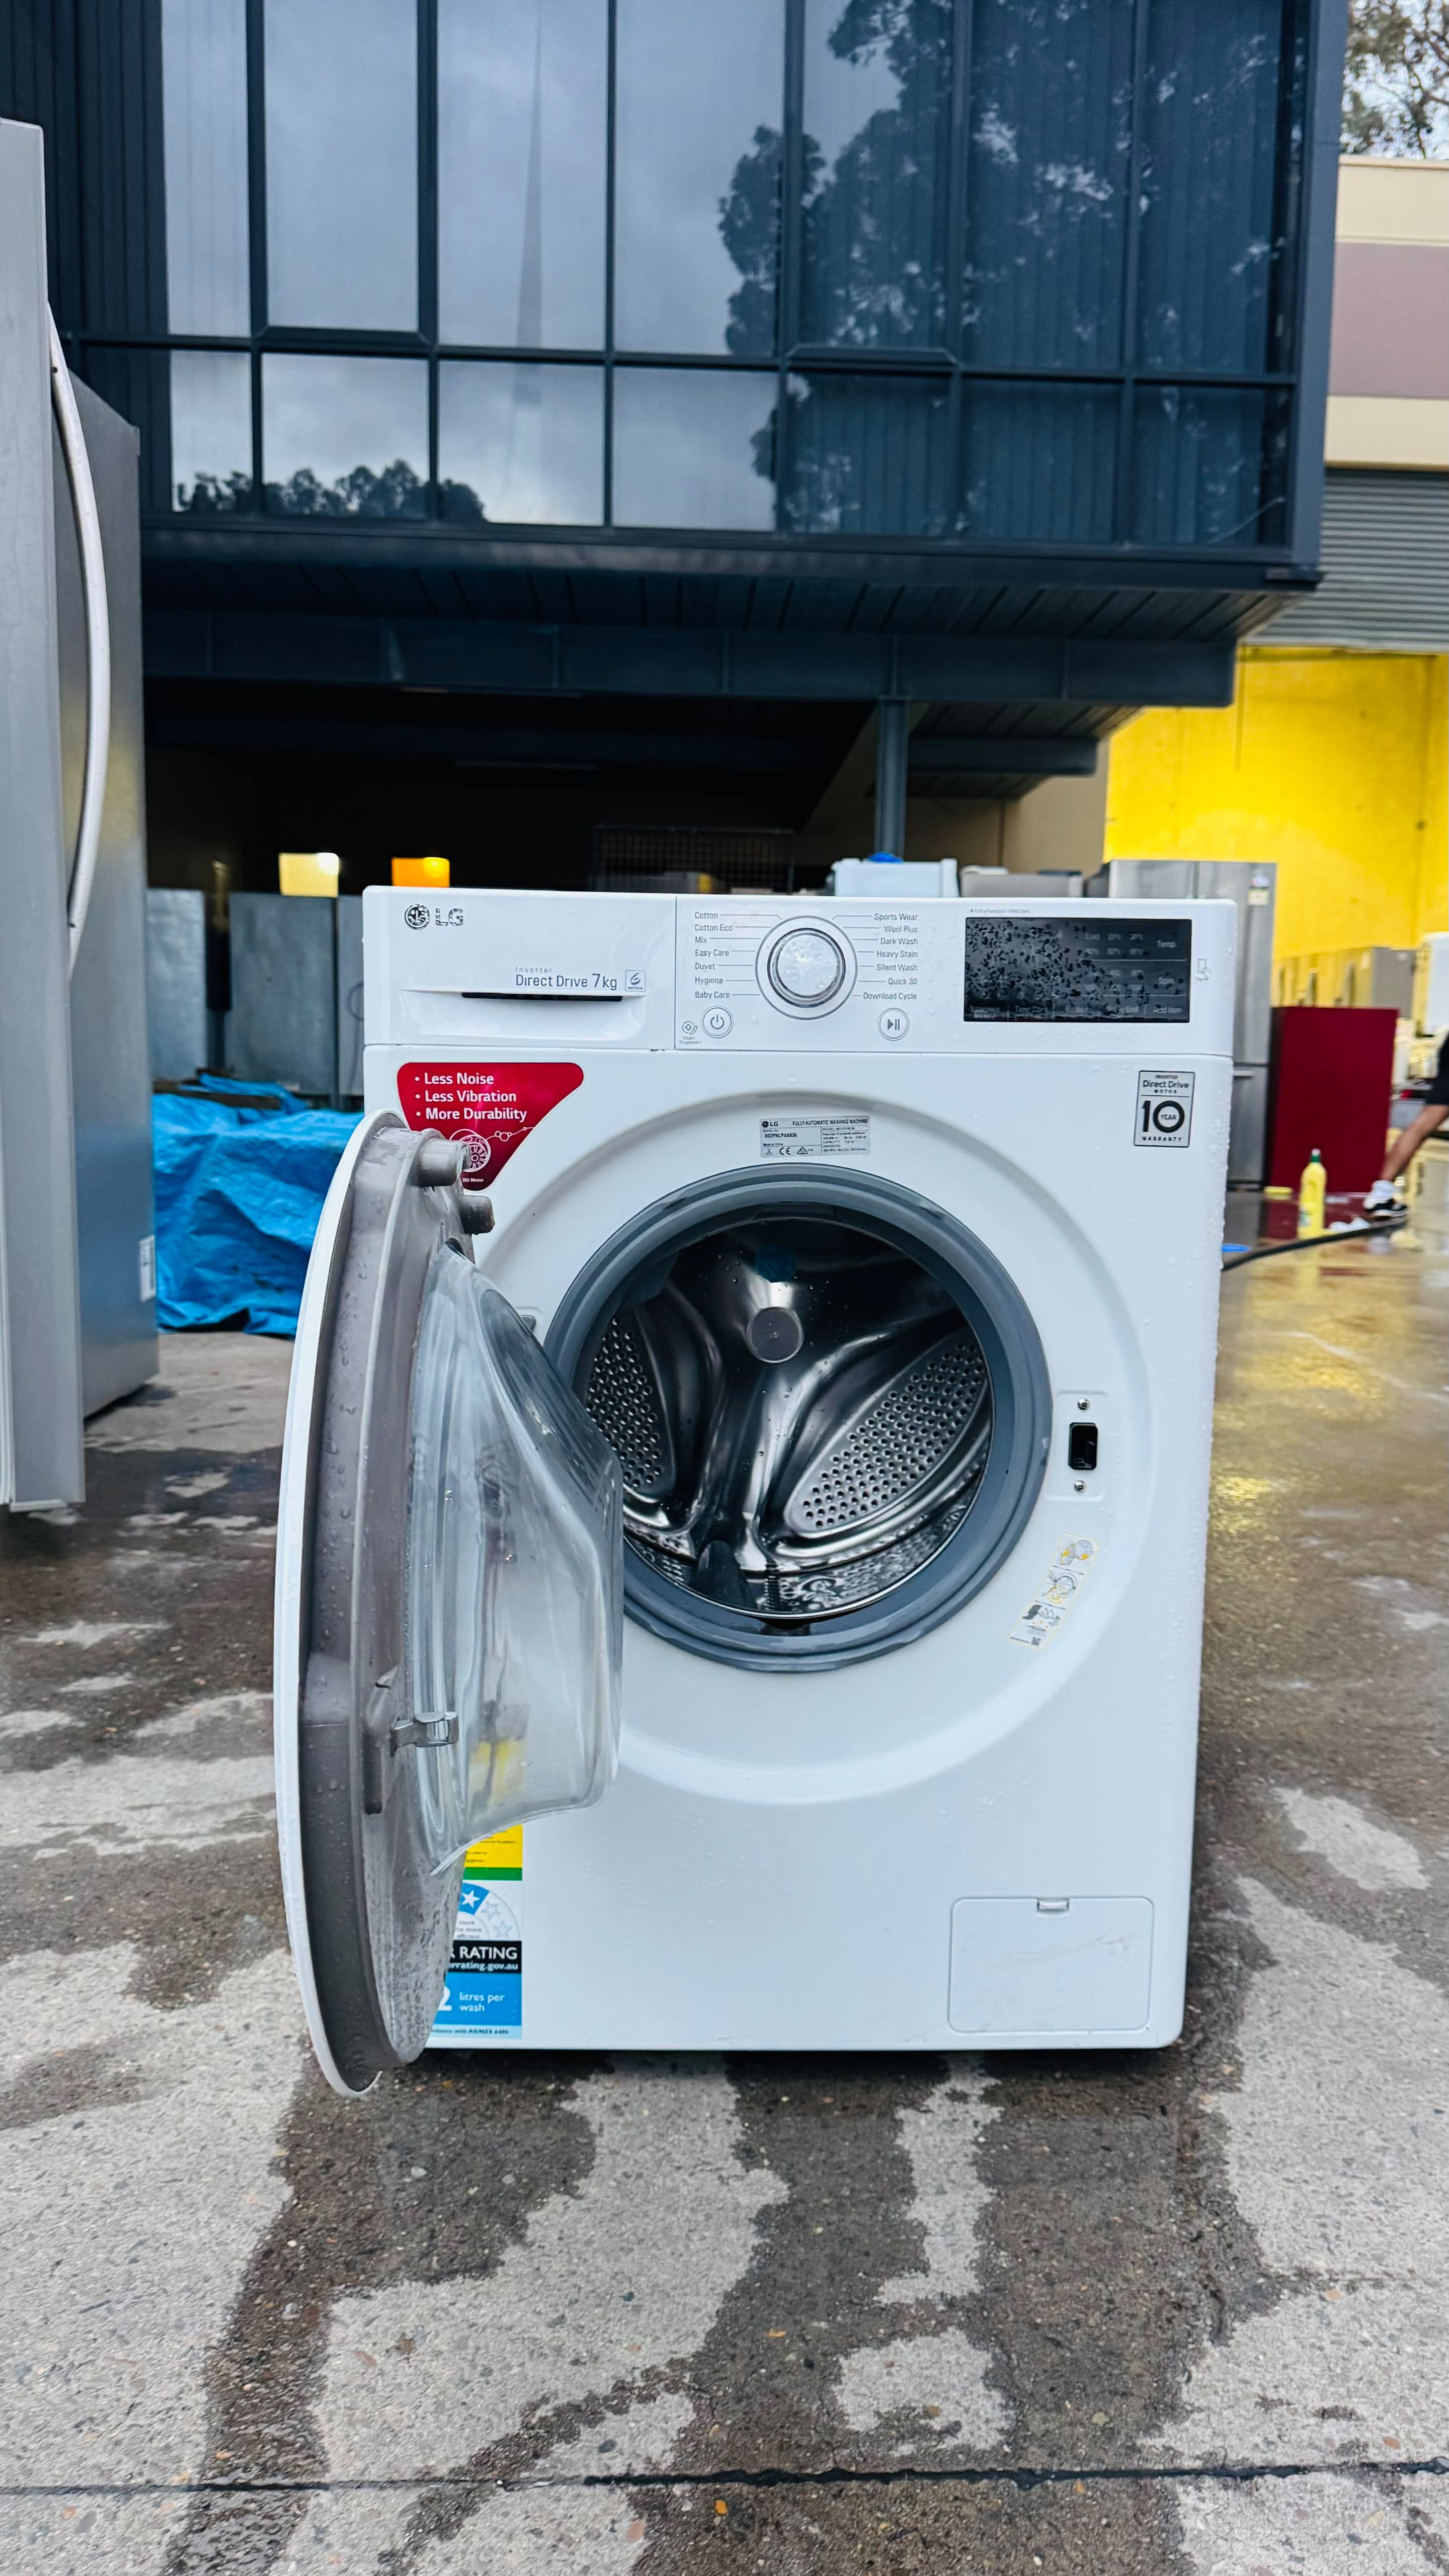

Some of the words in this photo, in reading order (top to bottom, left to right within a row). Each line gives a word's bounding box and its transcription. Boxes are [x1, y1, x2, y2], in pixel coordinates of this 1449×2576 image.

[435, 908, 463, 926] LG
[695, 911, 718, 919] Cotton
[874, 913, 898, 921] Sports
[695, 949, 712, 957] Easy
[876, 950, 899, 959] Heavy
[695, 962, 716, 970] Duvet
[898, 963, 918, 972] Wash
[515, 974, 553, 987] Direct
[556, 975, 588, 987] Drive
[695, 976, 723, 986] Hygiene
[695, 991, 712, 1000] Baby
[898, 992, 917, 1000] Cycle
[424, 1072, 453, 1085] Less
[456, 1073, 495, 1085] Noise
[1143, 1080, 1166, 1088] Direct
[1168, 1081, 1189, 1089] Drive
[425, 1090, 453, 1102] Less
[456, 1090, 517, 1102] Vibration
[425, 1107, 460, 1120] More
[463, 1107, 527, 1123] Durability
[459, 1946, 518, 1960] RATING
[449, 1961, 519, 1972] rrating.gov.au
[459, 1992, 485, 2001] litres
[487, 1994, 506, 2003] per
[459, 2002, 485, 2012] wash
